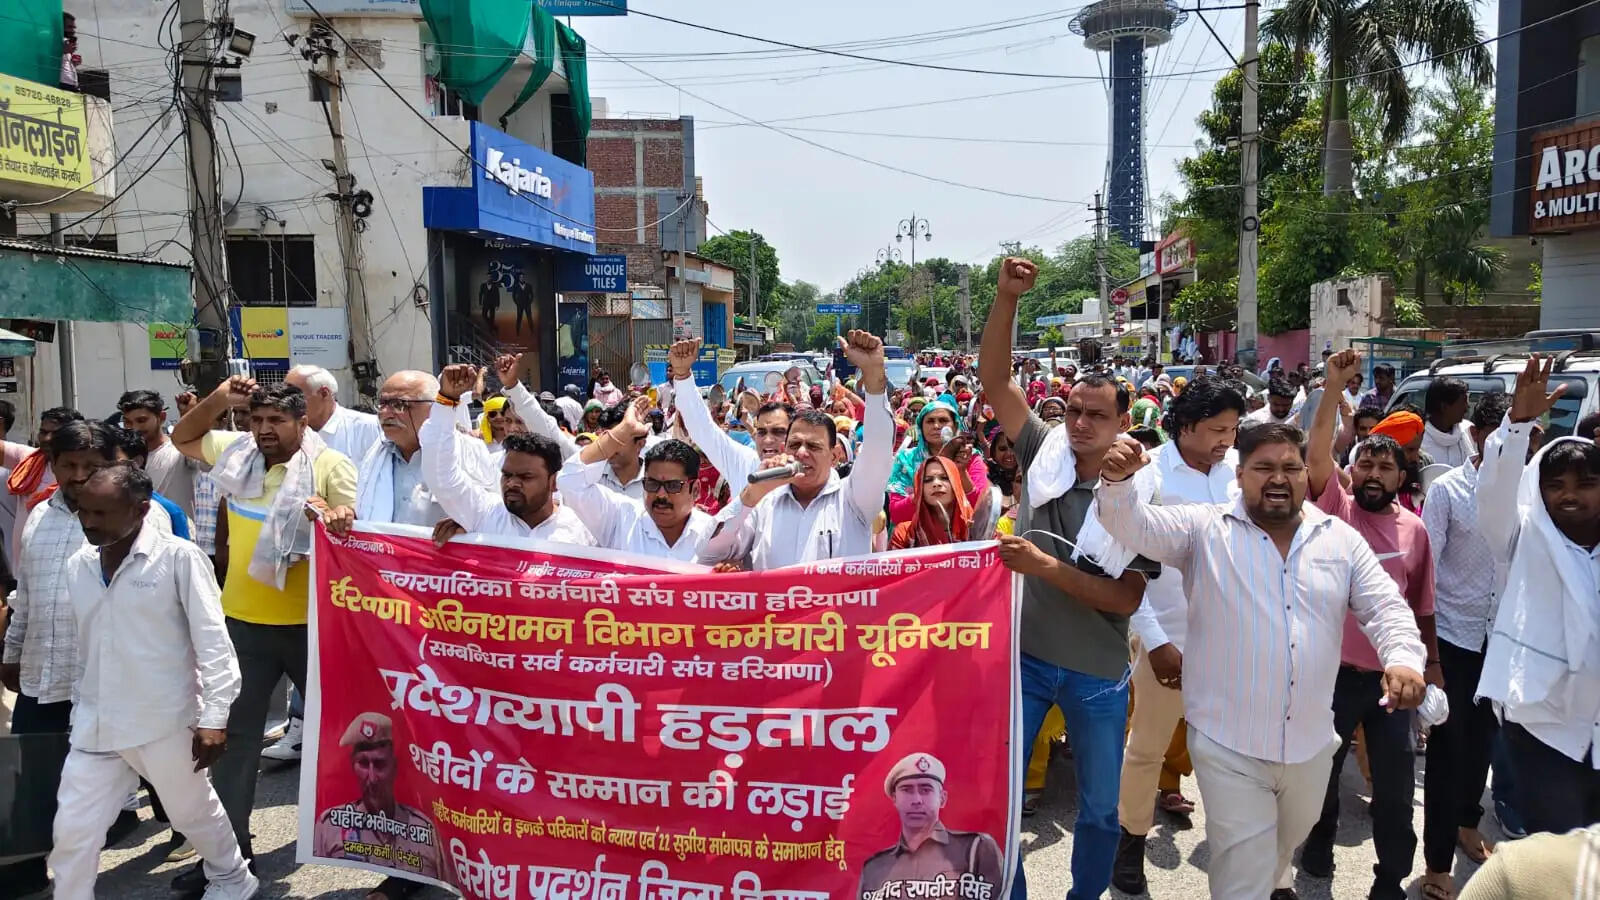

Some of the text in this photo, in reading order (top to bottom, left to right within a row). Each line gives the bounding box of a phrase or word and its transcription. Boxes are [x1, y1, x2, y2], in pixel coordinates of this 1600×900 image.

[485, 147, 552, 196] Kajaria
[1534, 200, 1546, 219] &
[585, 264, 624, 275] UNIQUE
[592, 277, 617, 289] TILES
[958, 552, 982, 569] करो
[378, 569, 879, 612] नगरपालिका कर्मचारी संघ शाखा हरियाणा
[583, 608, 696, 648] विभाग
[704, 613, 848, 652] कर्मचारी
[856, 612, 992, 667] यूनियन
[522, 648, 563, 673] सर्व
[568, 652, 665, 677] कर्मचारी
[672, 655, 715, 678] संघ
[377, 663, 898, 768] प्रदेशव्यापी हड़ताल
[408, 740, 855, 832] शहीदों के सम्मान की लड़ाई
[330, 804, 363, 829] शहीद
[503, 817, 513, 835] व
[547, 815, 589, 841] परिवारों
[591, 820, 606, 844] को
[608, 828, 638, 848] न्याय
[709, 831, 752, 858] मांगपत्र
[755, 833, 770, 860] के
[772, 841, 822, 862] समाधान
[905, 874, 957, 898] रणवीर
[959, 872, 994, 899] सिंह
